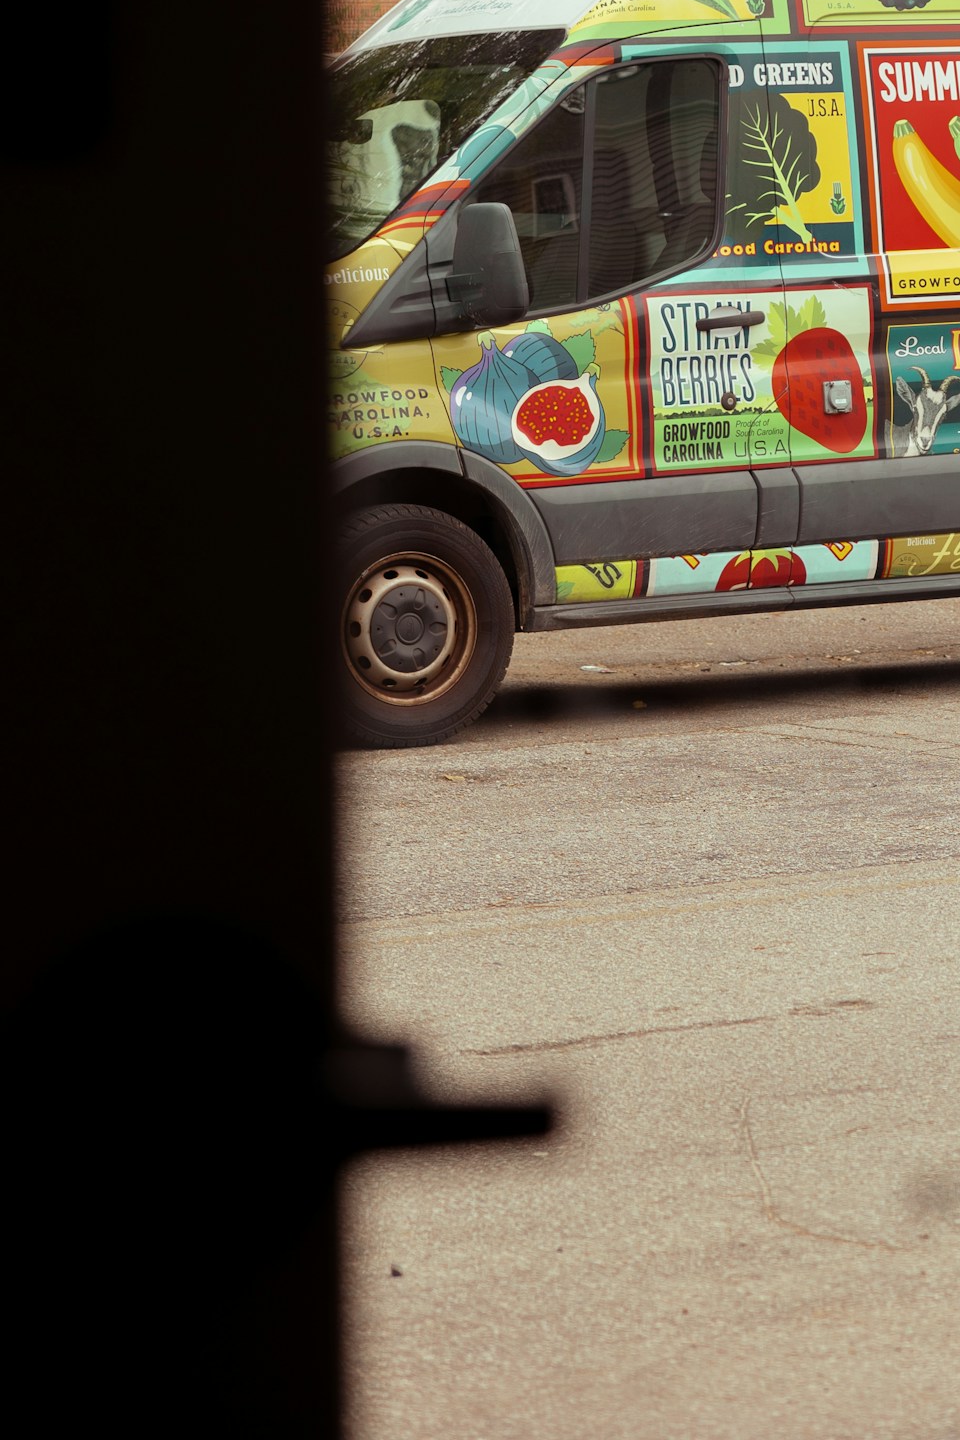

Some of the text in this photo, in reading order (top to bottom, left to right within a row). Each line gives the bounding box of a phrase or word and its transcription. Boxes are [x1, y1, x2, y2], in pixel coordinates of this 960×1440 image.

[606, 6, 626, 14] South
[627, 4, 656, 12] Carolina
[753, 62, 834, 86] GREENS
[764, 237, 840, 255] Carolina
[895, 336, 947, 357] Local
[661, 353, 755, 406] BERRIES
[334, 388, 429, 405] ROWFOOD
[663, 420, 731, 442] GROWFOOD
[735, 418, 770, 428] Product of
[353, 425, 410, 440] U.S.A.
[735, 427, 784, 438] South Carolina
[663, 442, 724, 463] CAROLINA
[906, 536, 936, 547] Delicious
